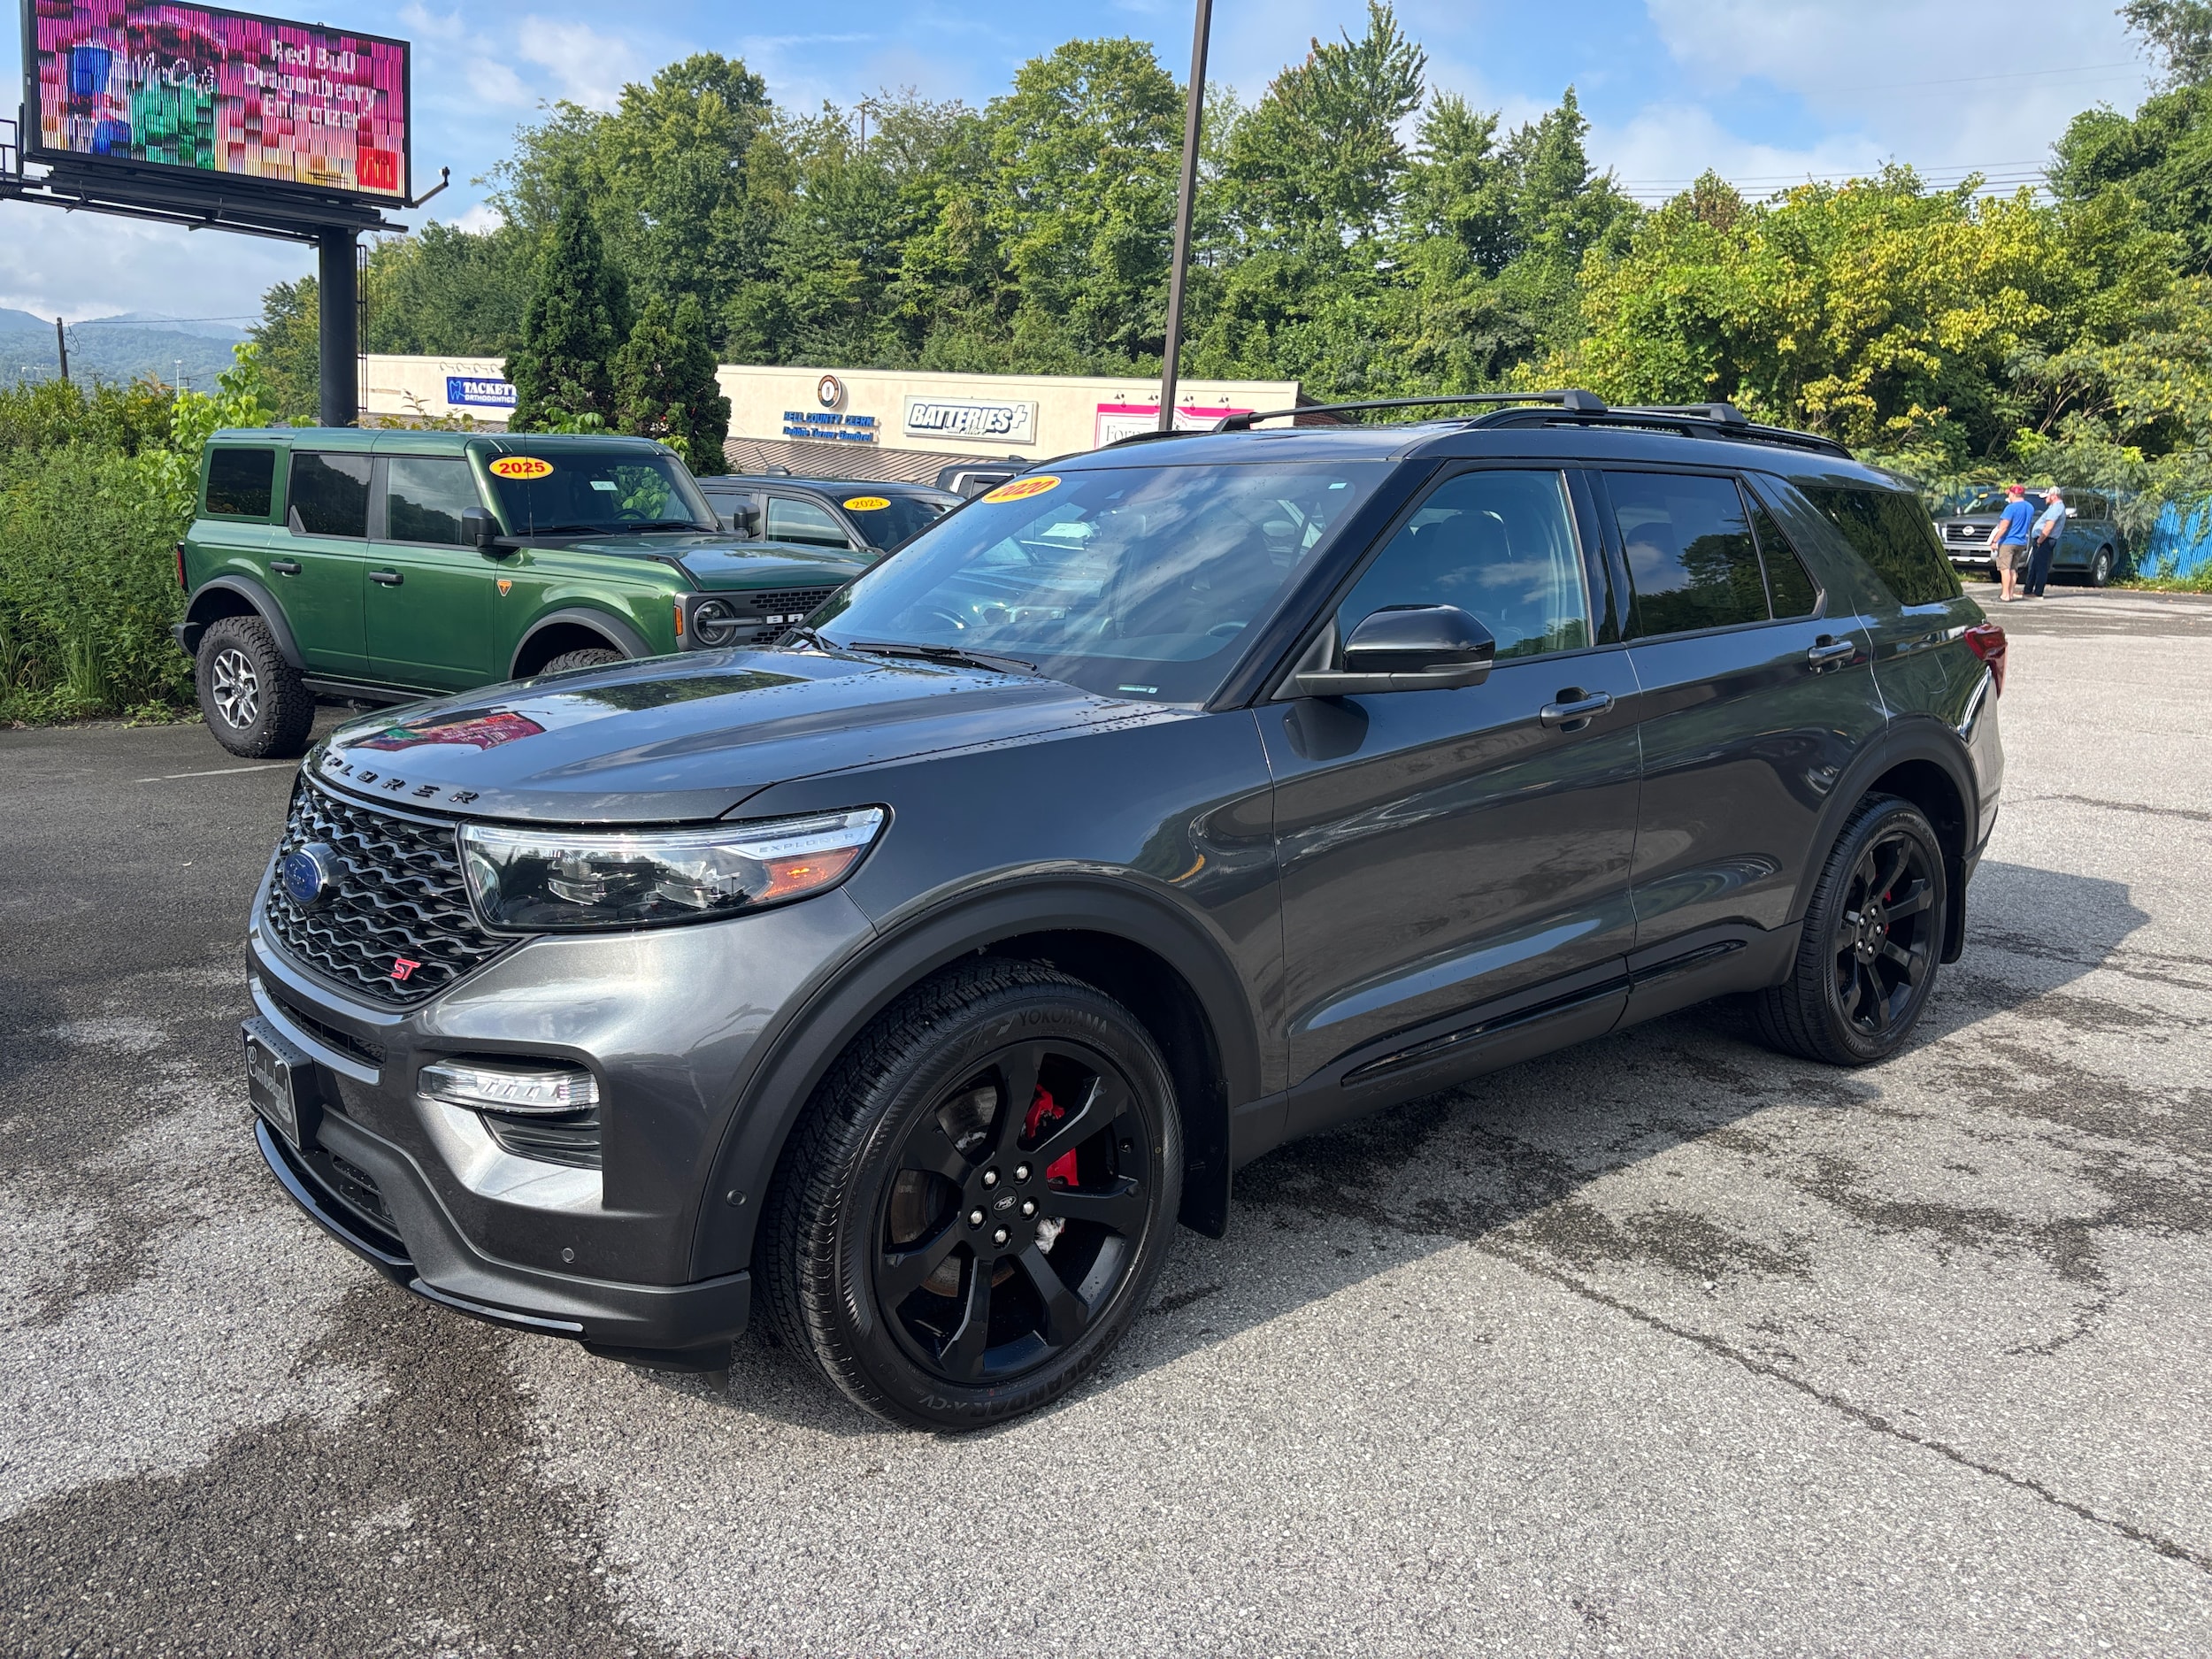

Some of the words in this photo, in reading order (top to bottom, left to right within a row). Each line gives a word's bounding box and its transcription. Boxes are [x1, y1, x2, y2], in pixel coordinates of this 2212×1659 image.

[270, 39, 311, 67] Red
[315, 47, 356, 74] Bull
[244, 62, 378, 118] Dragonberry
[464, 393, 517, 404] ORTHODONTICS
[783, 411, 804, 422] BELL
[805, 412, 843, 426] COUNTY
[845, 414, 875, 427] CLERK
[782, 426, 810, 437] Debbie
[810, 427, 838, 440] Turner
[499, 461, 546, 475] 2025
[985, 479, 1056, 500] 2020
[852, 498, 883, 510] 2025
[758, 833, 852, 853] EXPLORER
[390, 958, 422, 980] ST
[1018, 1008, 1109, 1035] YOKOHAMA
